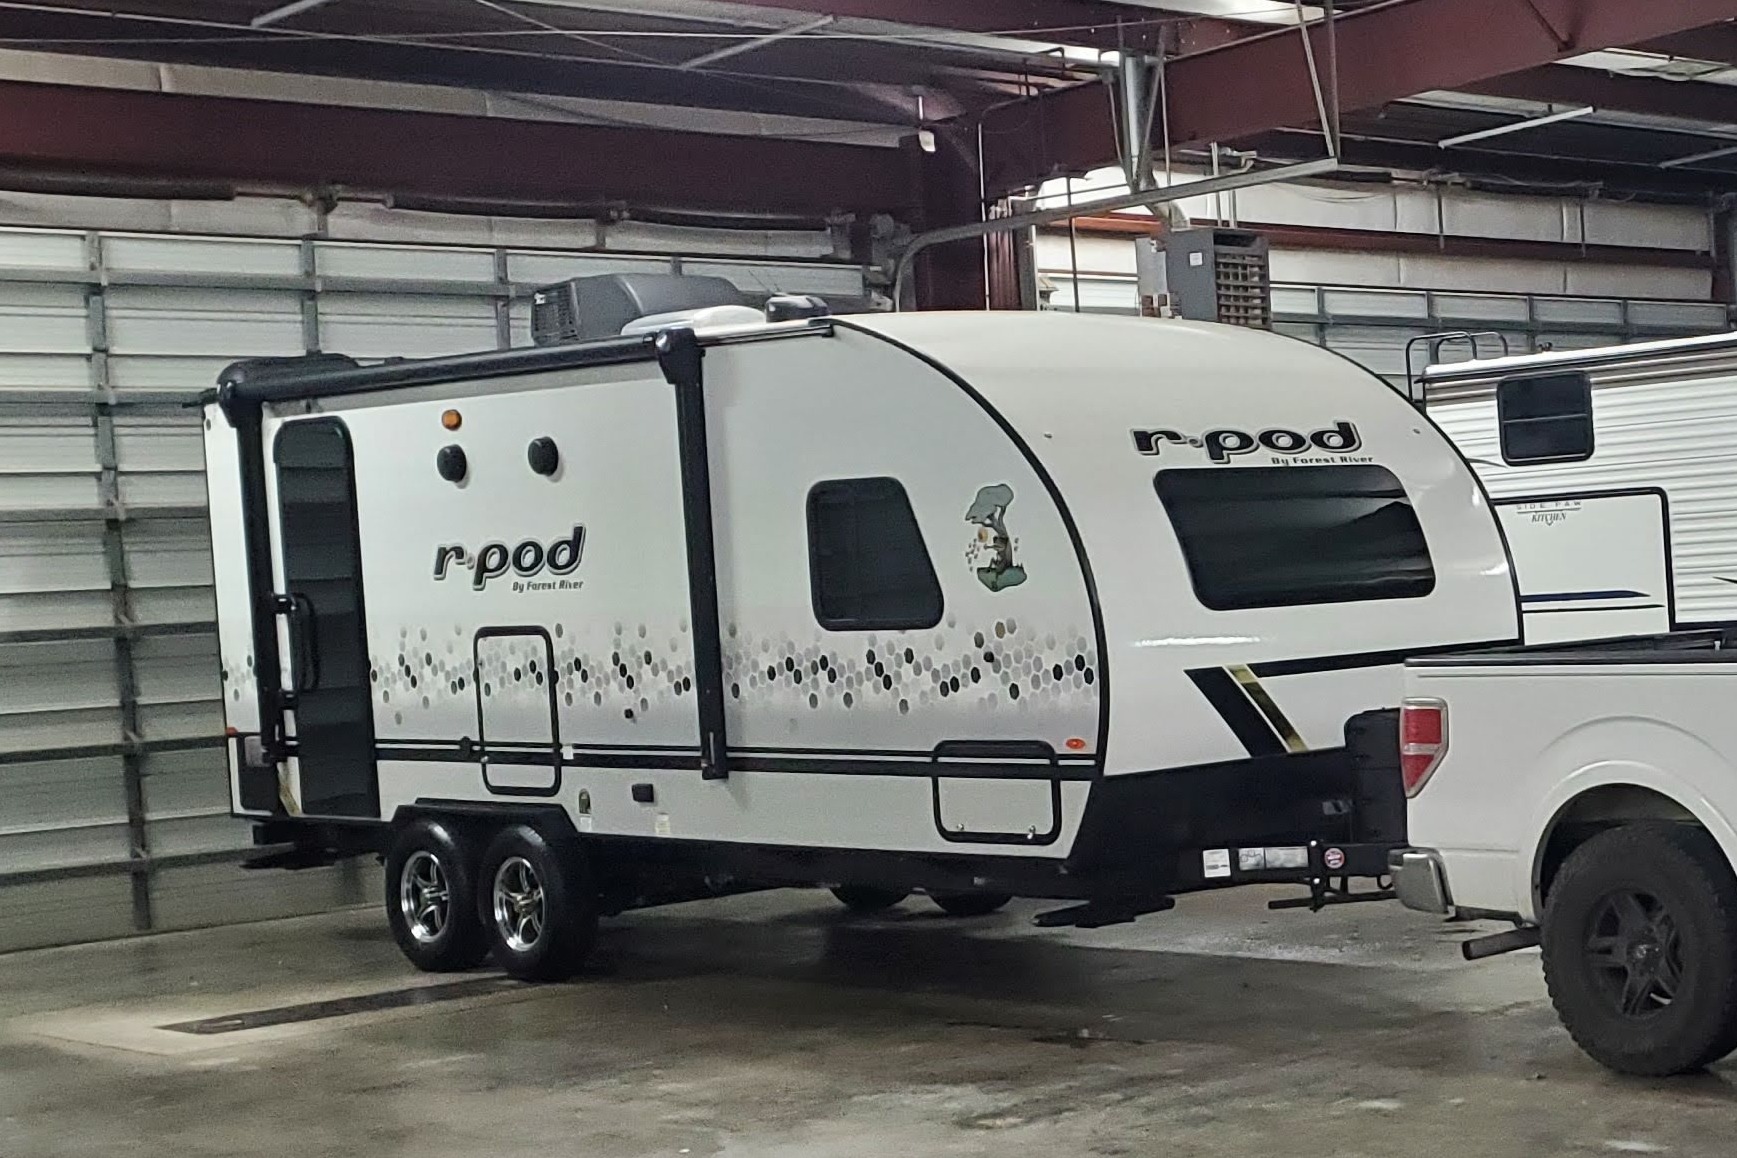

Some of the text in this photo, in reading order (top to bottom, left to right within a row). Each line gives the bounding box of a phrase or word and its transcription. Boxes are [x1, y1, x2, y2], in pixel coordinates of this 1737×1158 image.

[1271, 455, 1374, 466] By Forest River
[1531, 512, 1567, 526] KITCHEN
[512, 579, 584, 593] By Forest River
